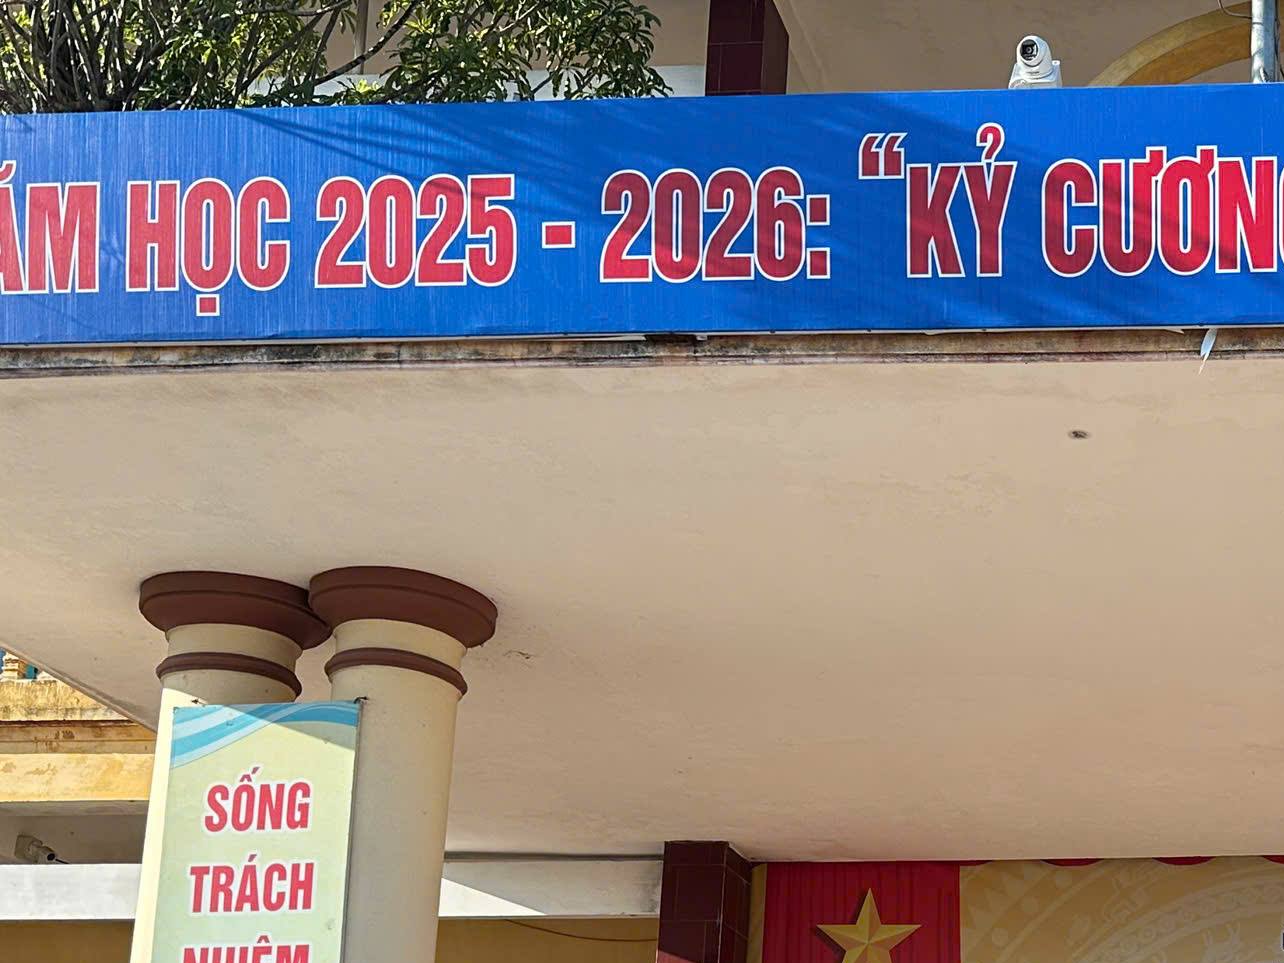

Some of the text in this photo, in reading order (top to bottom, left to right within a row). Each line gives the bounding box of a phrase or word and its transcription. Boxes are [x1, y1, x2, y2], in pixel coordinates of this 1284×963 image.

[126, 177, 290, 317] HỌC
[314, 173, 518, 289] 2025
[599, 165, 832, 283] 2026:
[203, 764, 312, 833] SỐNG
[189, 853, 315, 913] TRÁCH
